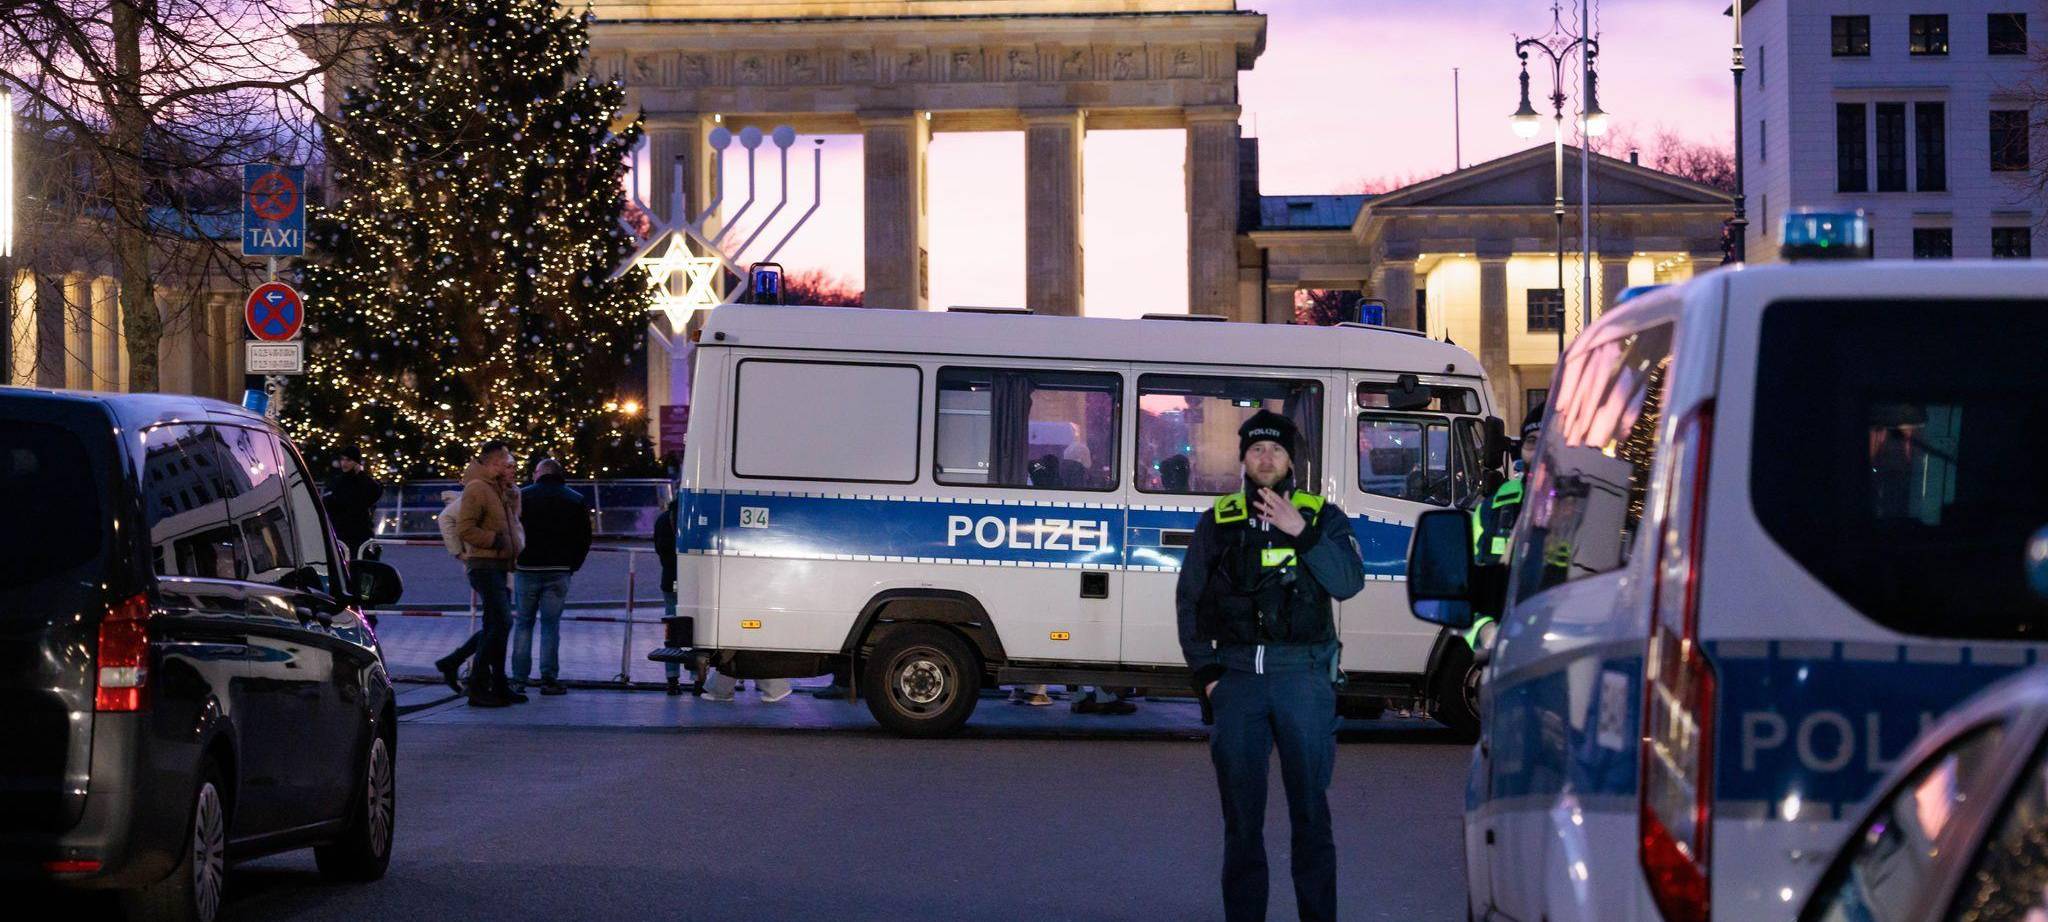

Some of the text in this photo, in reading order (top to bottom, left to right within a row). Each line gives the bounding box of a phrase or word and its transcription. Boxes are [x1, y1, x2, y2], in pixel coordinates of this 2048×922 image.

[249, 228, 298, 248] TAXI
[1248, 427, 1280, 438] POLIZEI
[742, 509, 767, 526] 34
[947, 515, 1109, 551] POLIZEI
[1742, 711, 1935, 773] POL
